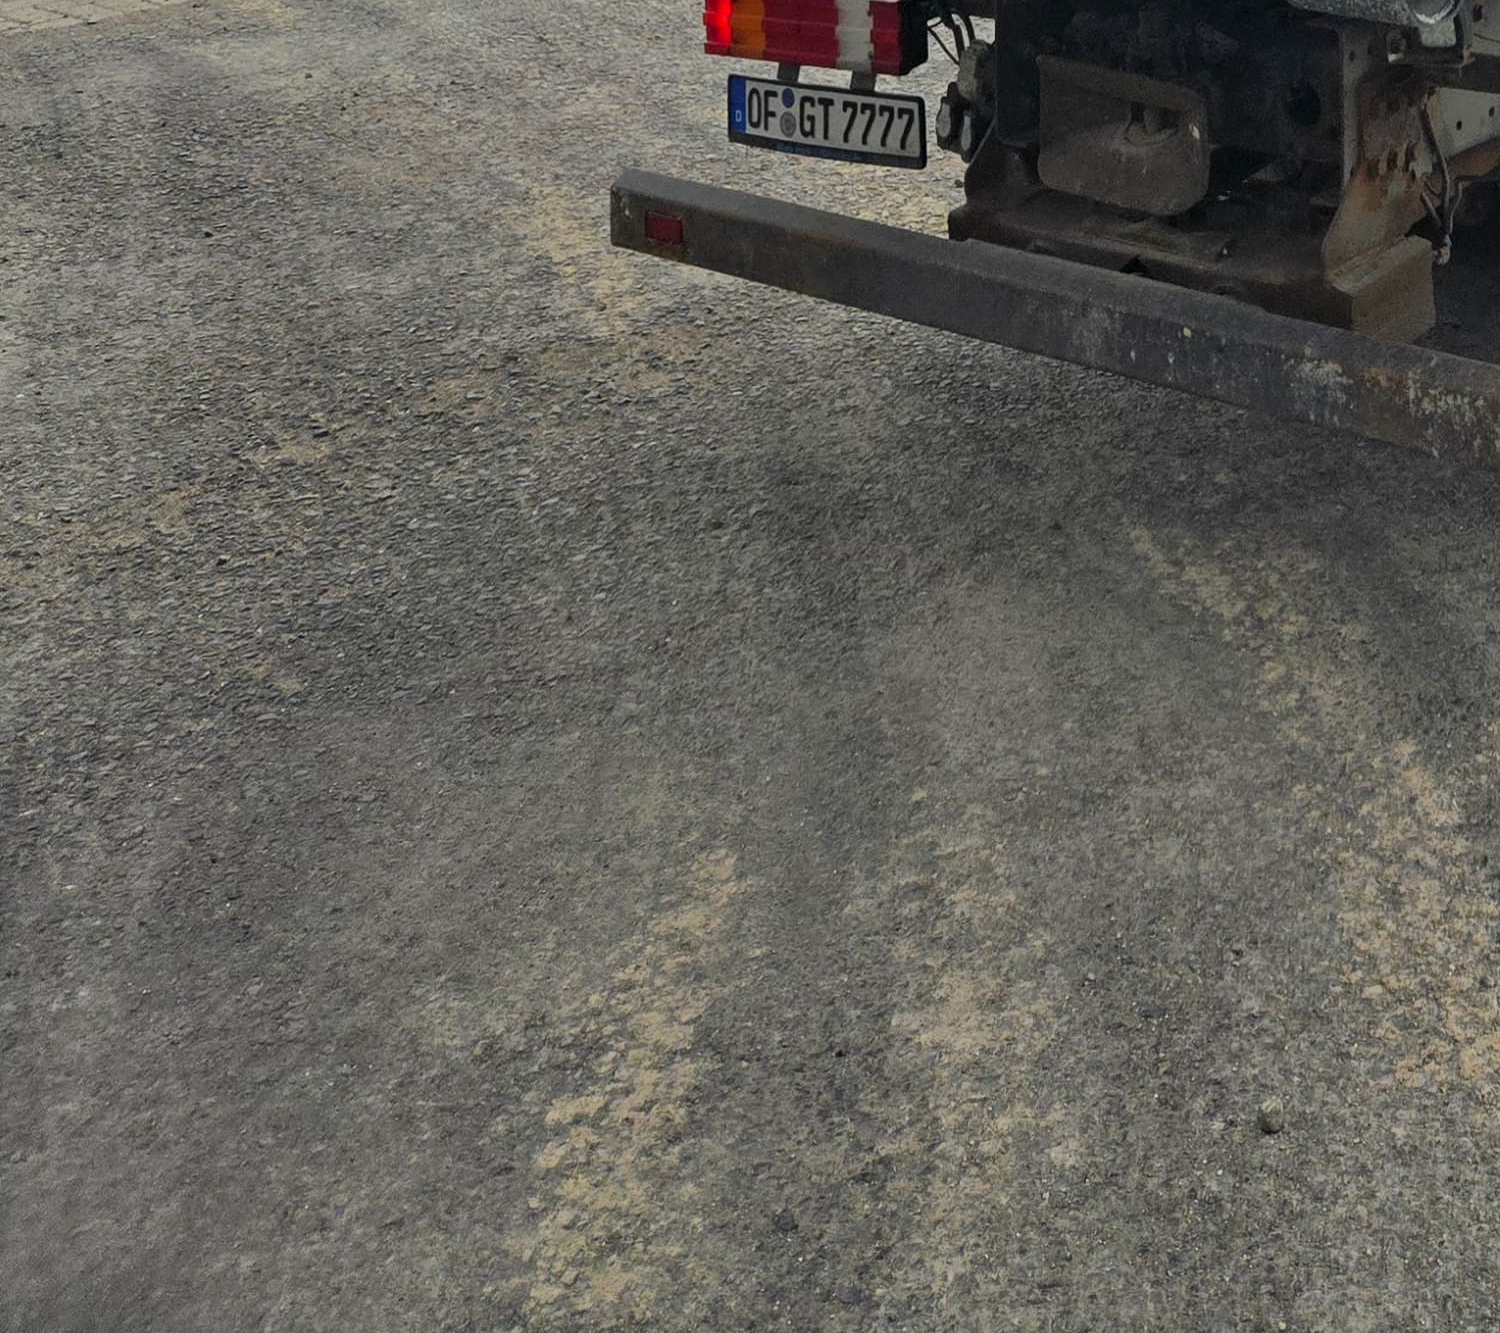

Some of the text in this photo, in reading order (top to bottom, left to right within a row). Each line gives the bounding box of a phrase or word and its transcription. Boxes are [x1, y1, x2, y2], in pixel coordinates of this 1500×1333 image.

[735, 110, 742, 122] D
[749, 87, 778, 131] OF
[800, 95, 834, 140] GT
[842, 100, 914, 150] 7777
